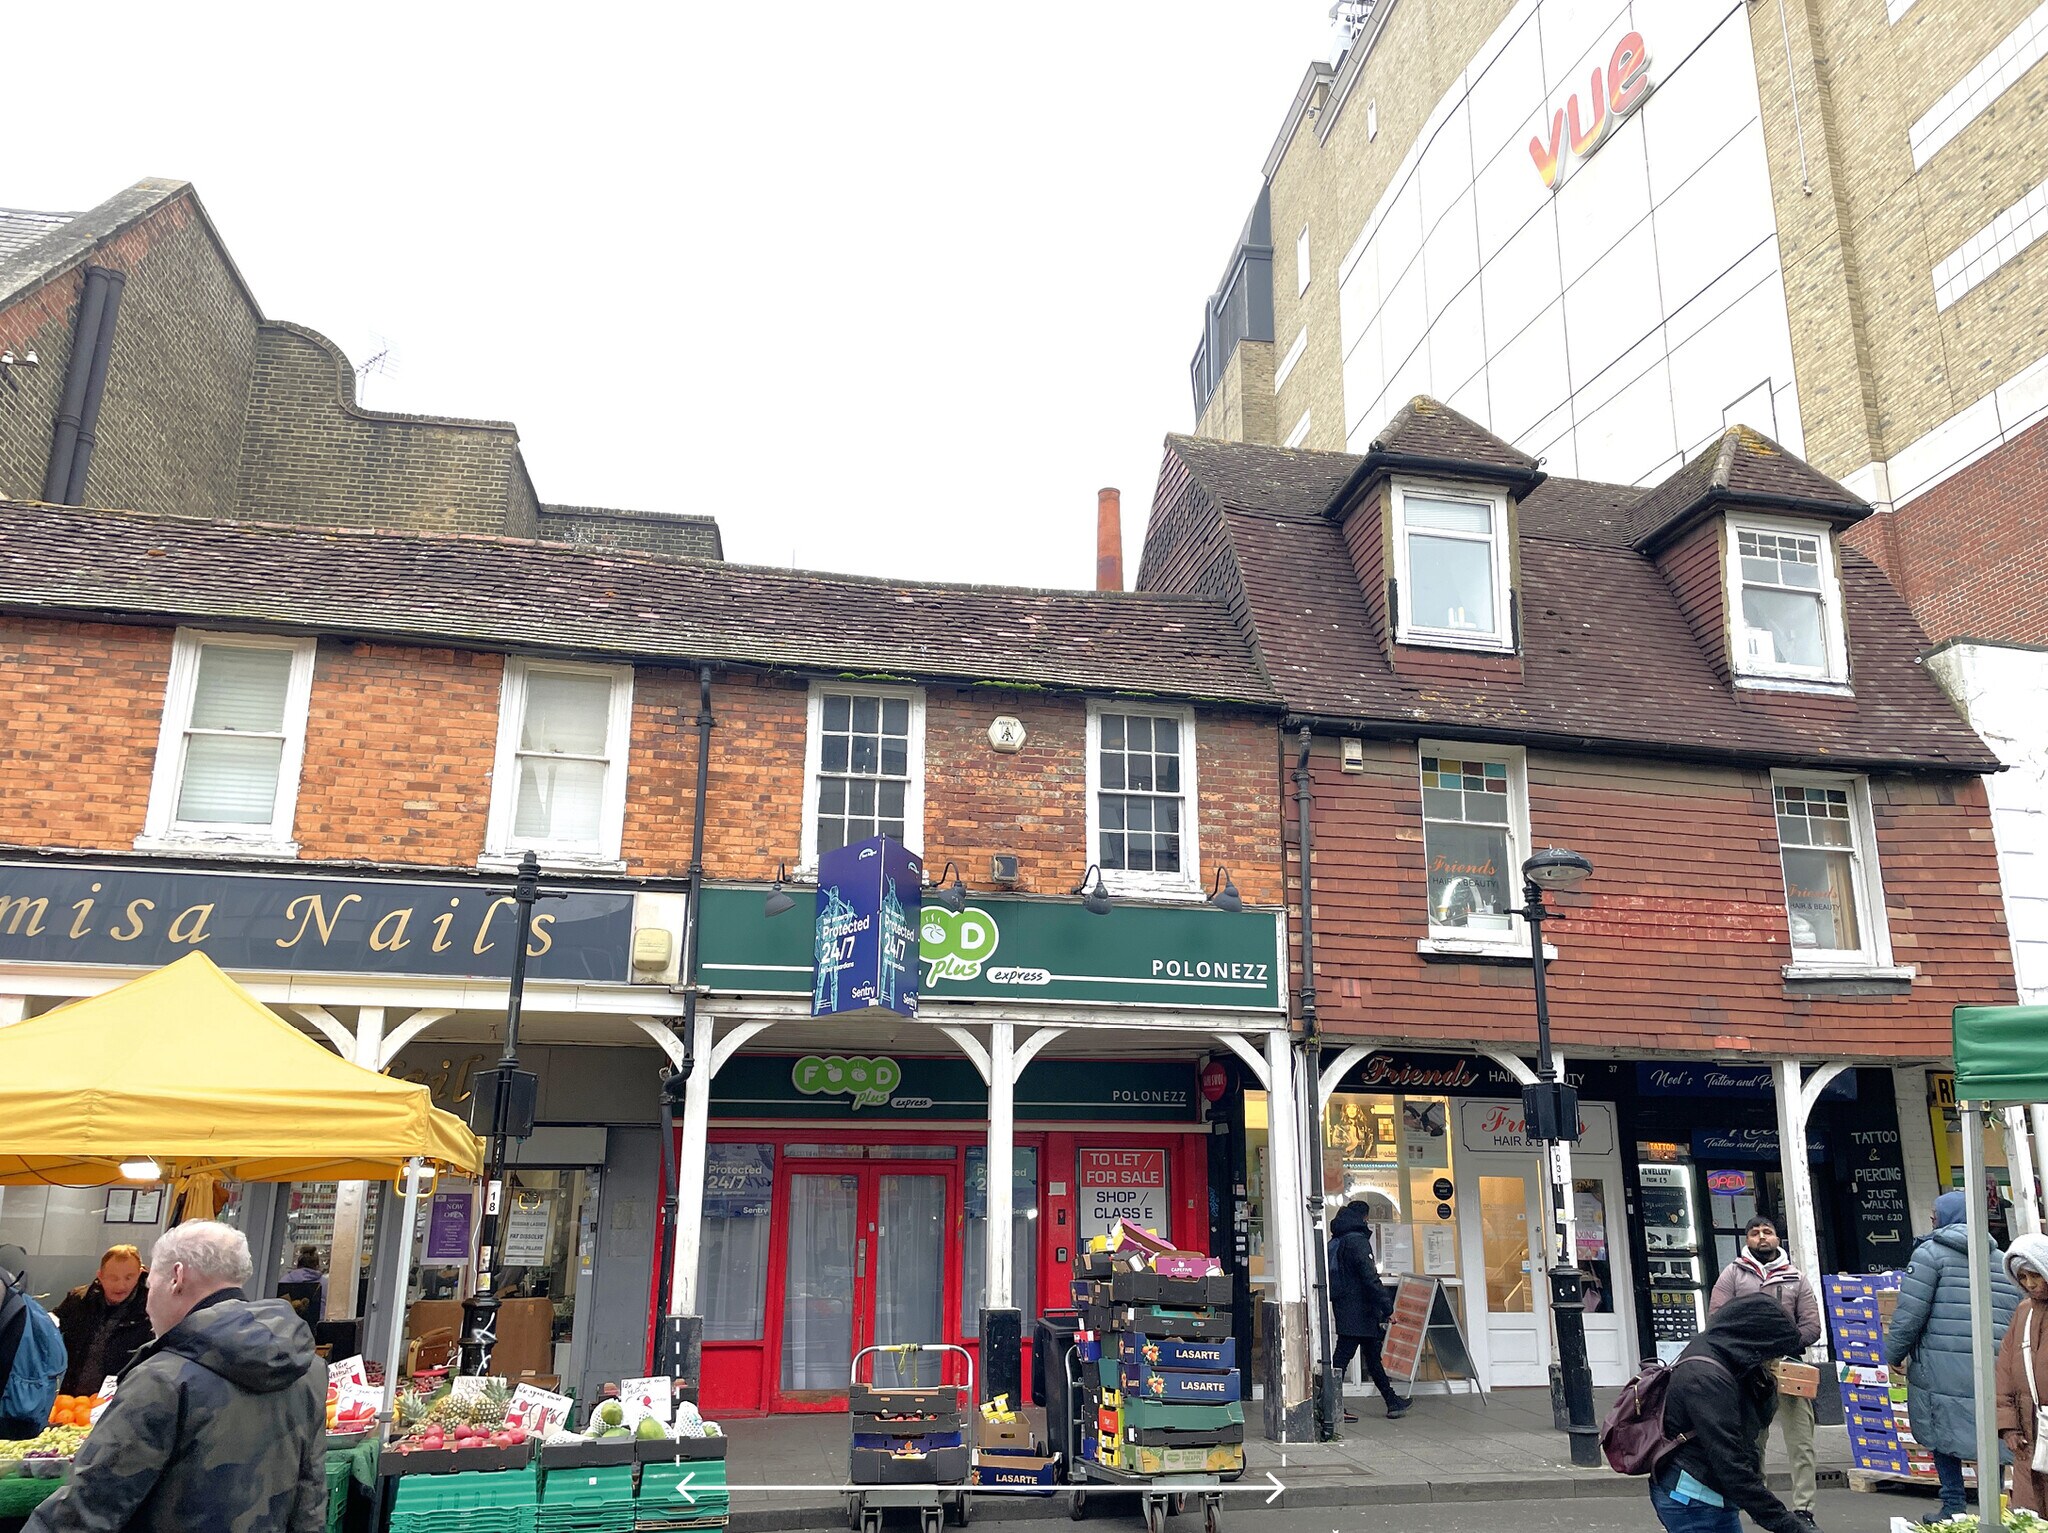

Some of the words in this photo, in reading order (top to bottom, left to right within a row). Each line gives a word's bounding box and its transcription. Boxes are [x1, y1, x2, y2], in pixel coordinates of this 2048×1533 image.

[1529, 32, 1654, 188] vue
[1428, 854, 1497, 877] Friends
[1433, 877, 1451, 885] HAIR
[1463, 878, 1497, 888] BEAUTY
[1789, 884, 1838, 898] Friends
[275, 893, 556, 957] Nails
[822, 914, 870, 940] Protected
[884, 914, 915, 942] Protected
[821, 935, 856, 964] 24/7
[884, 932, 906, 962] 24/7
[930, 958, 978, 984] plus
[994, 969, 1043, 984] express
[1152, 959, 1268, 981] POLONEZZ
[851, 985, 876, 999] Sentry
[1361, 1055, 1479, 1087] Friends
[1608, 1065, 1618, 1073] 37
[1650, 1069, 1694, 1088] Neel's
[1703, 1072, 1736, 1089] Tattoo
[1736, 1075, 1758, 1087] and
[855, 1089, 887, 1108] plus
[1112, 1090, 1186, 1102] POLONEZZ
[895, 1099, 928, 1108] express
[1493, 1135, 1522, 1147] HAIR
[1525, 1138, 1533, 1147] &
[1703, 1137, 1736, 1149] Tattoo
[1736, 1138, 1757, 1149] and
[1851, 1131, 1898, 1144] TATTOO
[1649, 1142, 1676, 1151] TATTOO
[1090, 1153, 1110, 1165] TO
[1114, 1153, 1141, 1166] LET
[1869, 1148, 1880, 1161] &
[708, 1164, 762, 1174] Protected
[1641, 1168, 1672, 1177] JEWELLERY
[1855, 1167, 1901, 1182] PIERCING
[707, 1175, 746, 1189] 24/7
[1086, 1171, 1117, 1183] FOR
[1121, 1171, 1159, 1184] SALE
[1707, 1175, 1746, 1189] OPEN
[1096, 1191, 1136, 1203] SHOP
[1867, 1189, 1898, 1199] JUST
[743, 1206, 769, 1215] Sentry
[1861, 1200, 1892, 1209] WALK
[1892, 1200, 1904, 1209] IN
[1094, 1207, 1140, 1219] CLASS
[1145, 1207, 1153, 1218] E
[1887, 1213, 1903, 1221] £20
[1576, 1231, 1597, 1239] AXING
[1175, 1349, 1220, 1360] LASARTE
[1181, 1381, 1225, 1392] LASARTE
[996, 1473, 1038, 1485] LASARTE
